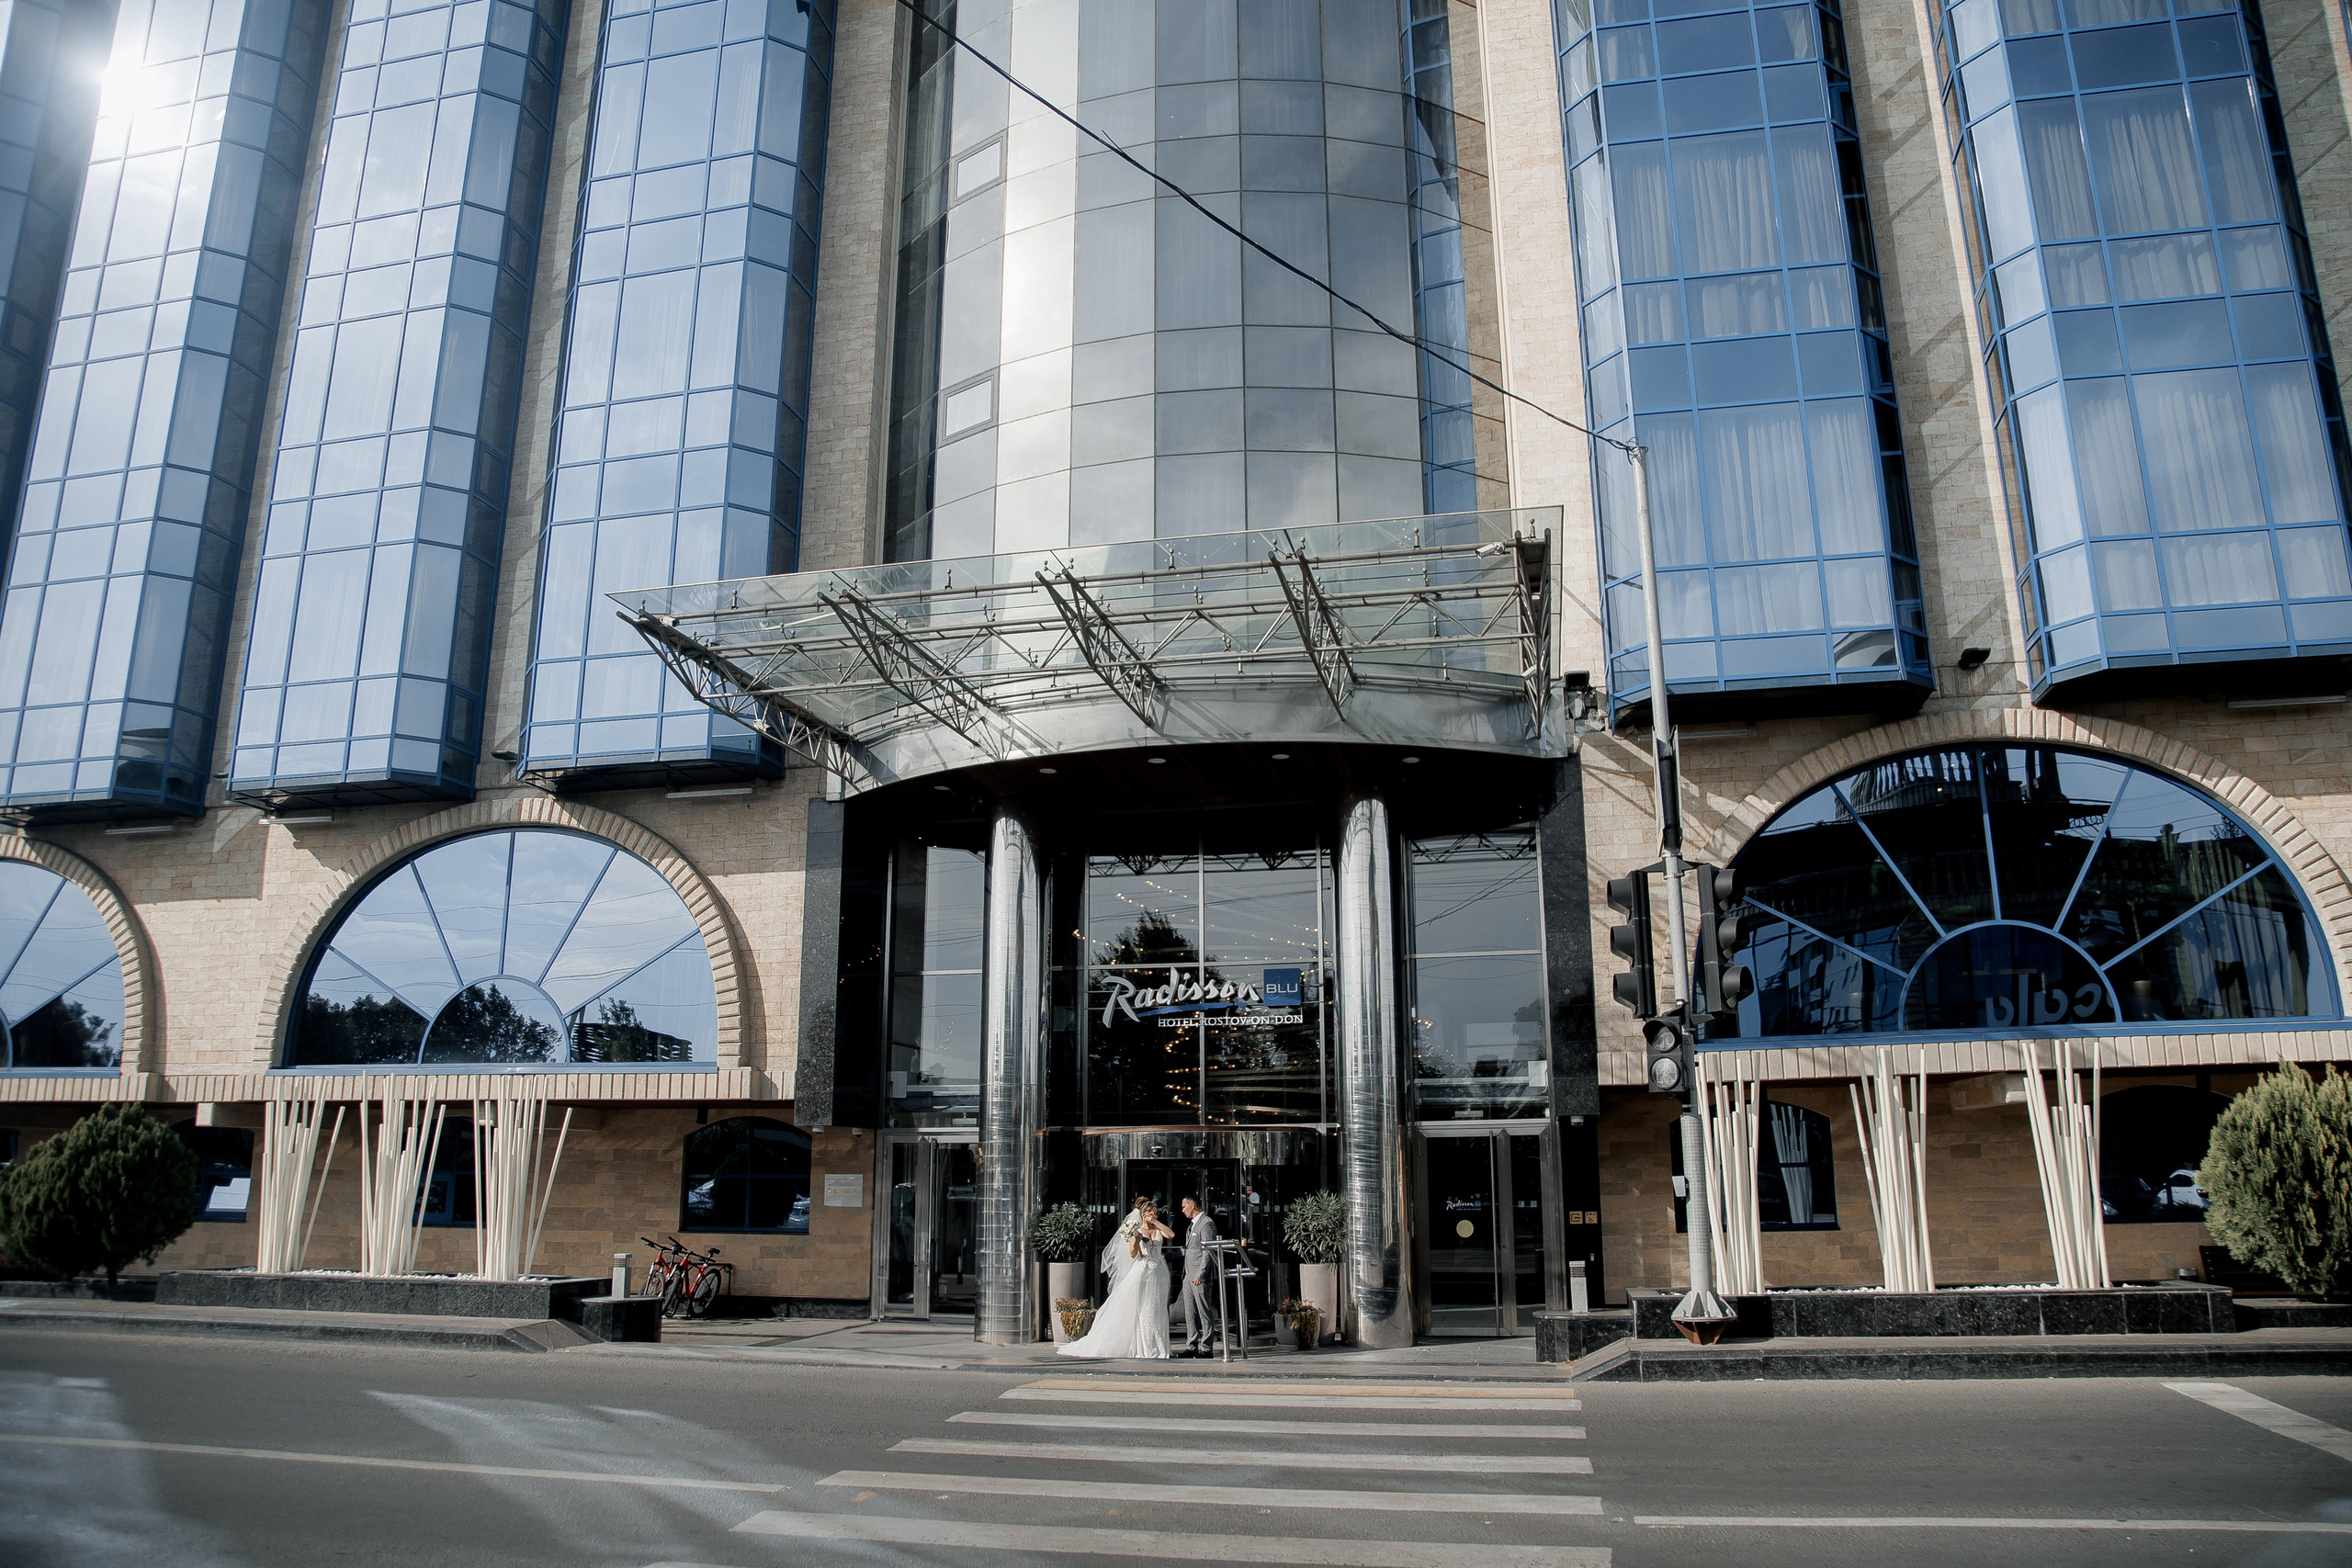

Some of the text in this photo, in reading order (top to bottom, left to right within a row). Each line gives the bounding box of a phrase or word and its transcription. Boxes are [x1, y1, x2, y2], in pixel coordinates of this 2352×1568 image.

[1101, 965, 1298, 1028] Radisson BLU
[1446, 1200, 1475, 1211] Radisson
